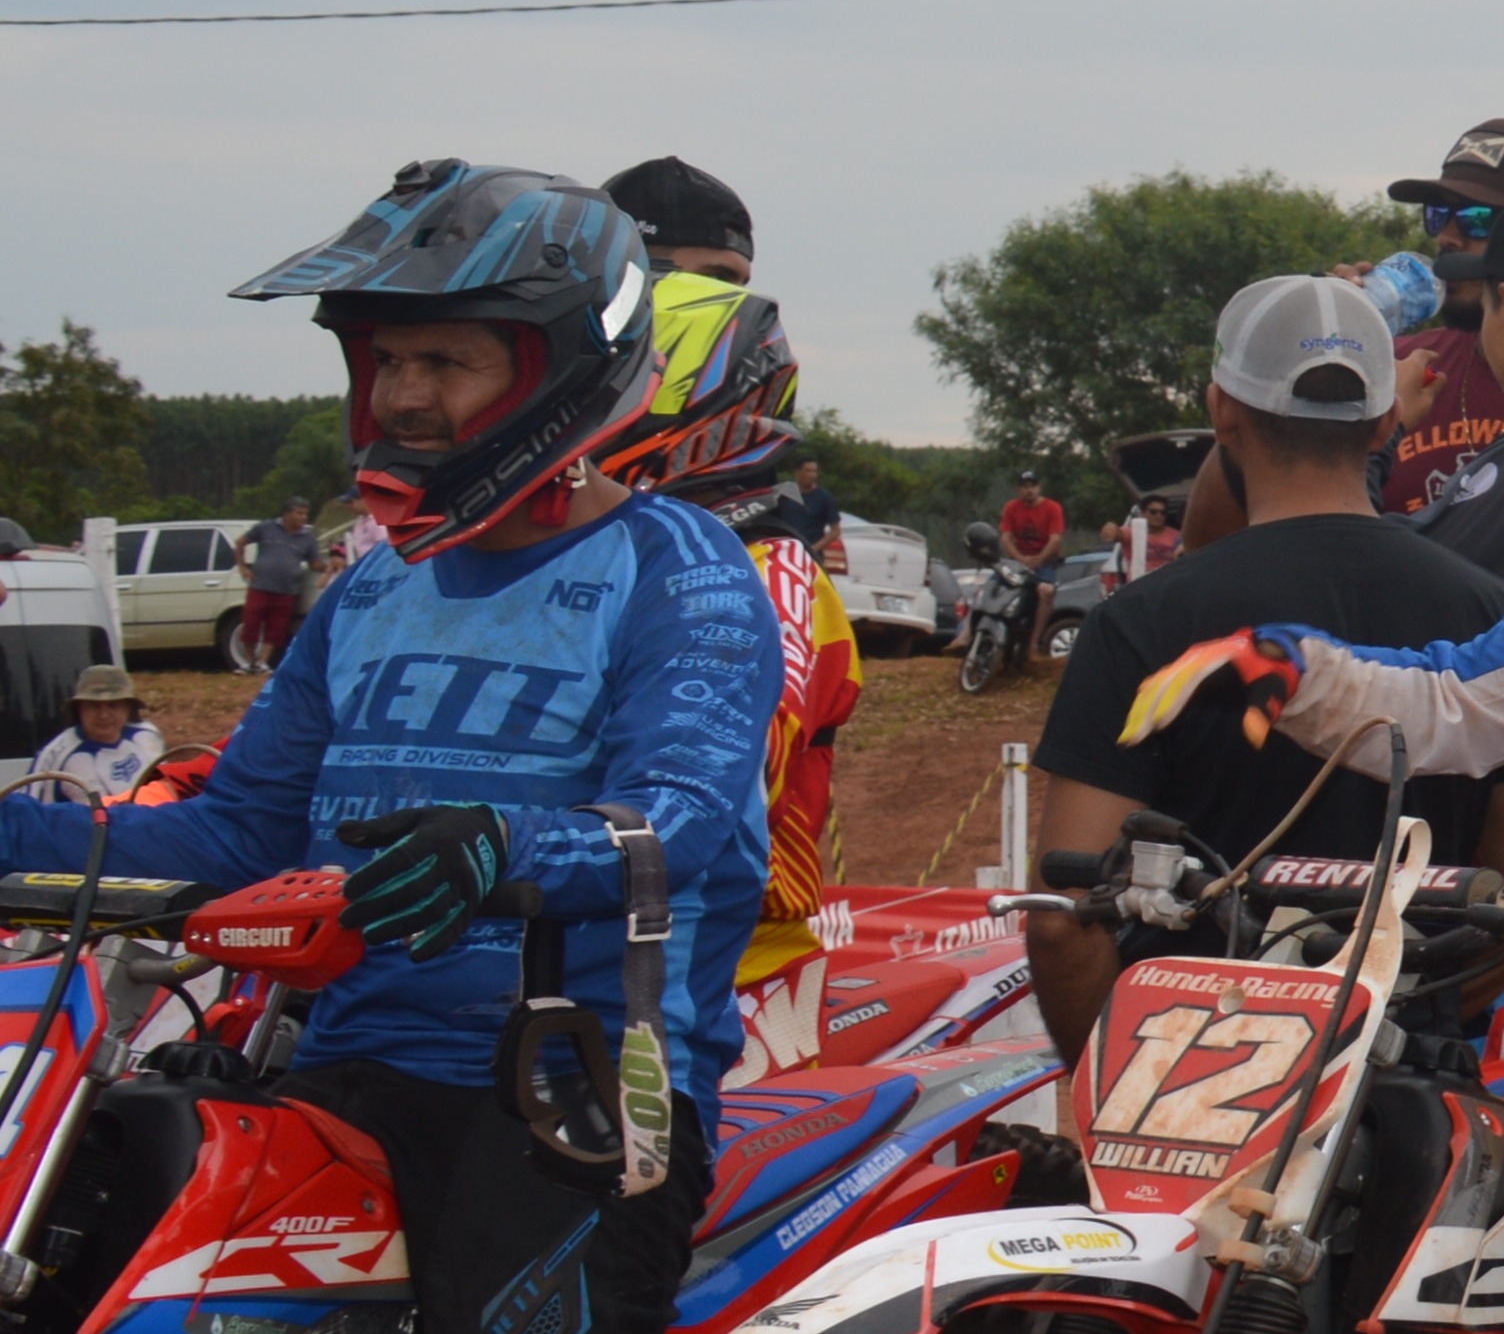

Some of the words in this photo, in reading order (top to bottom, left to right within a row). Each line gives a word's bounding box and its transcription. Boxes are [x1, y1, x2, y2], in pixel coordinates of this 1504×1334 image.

[1300, 336, 1363, 353] syngenta
[339, 747, 397, 764] RACING
[403, 751, 511, 769] DIVISION
[218, 926, 294, 948] CIRCUIT
[1130, 965, 1234, 995] Honda
[1090, 1003, 1315, 1150] 12
[739, 1111, 848, 1162] HONDA
[1091, 1140, 1233, 1181] WILLIAN
[269, 1216, 354, 1233] 400F
[1000, 1236, 1061, 1256] MEGA
[1062, 1231, 1121, 1250] POINT
